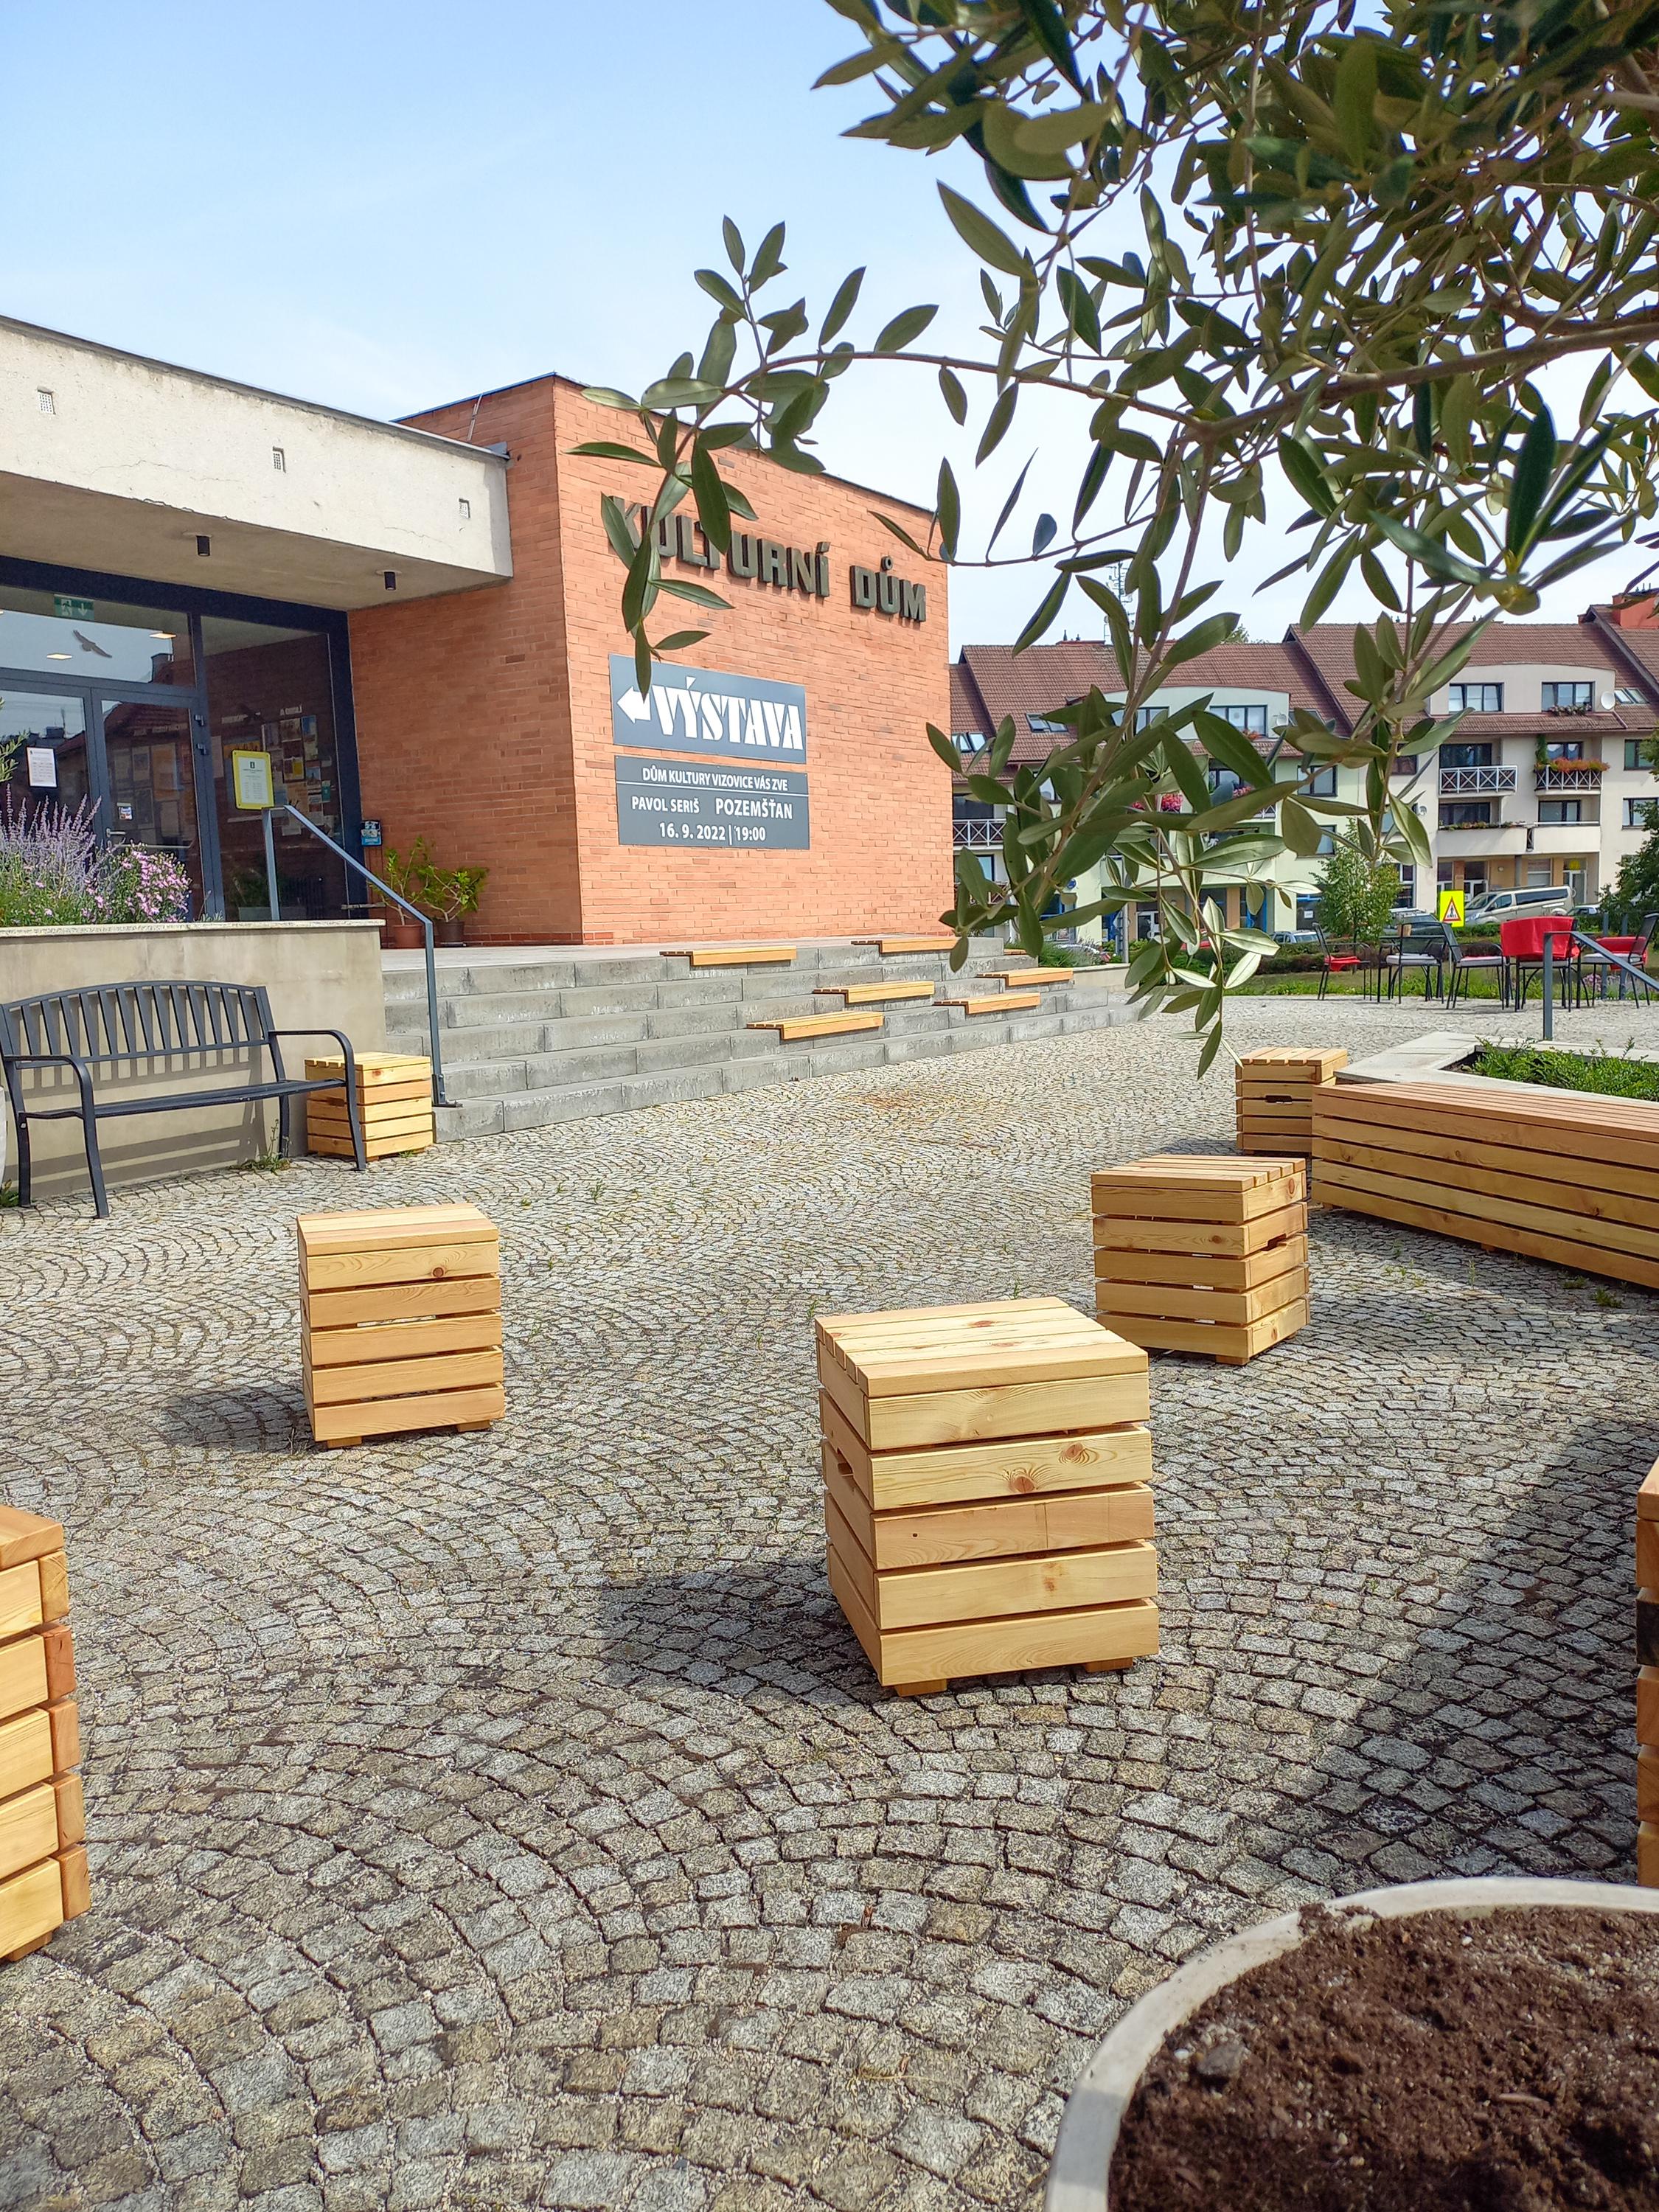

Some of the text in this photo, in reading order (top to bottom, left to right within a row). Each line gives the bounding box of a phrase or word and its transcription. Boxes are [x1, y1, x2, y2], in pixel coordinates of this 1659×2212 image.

[849, 555, 926, 622] DŮM
[652, 676, 803, 750] VÝSTAVA
[642, 765, 787, 791] DŮM KULTURY VIZOVICE VÁS ZVE
[632, 796, 793, 819] PAVOL SERIŠ POZEMŠŤAN
[659, 822, 678, 838] 16.
[681, 824, 694, 839] 9.
[696, 825, 726, 841] 2022
[734, 825, 766, 841] 19:00
